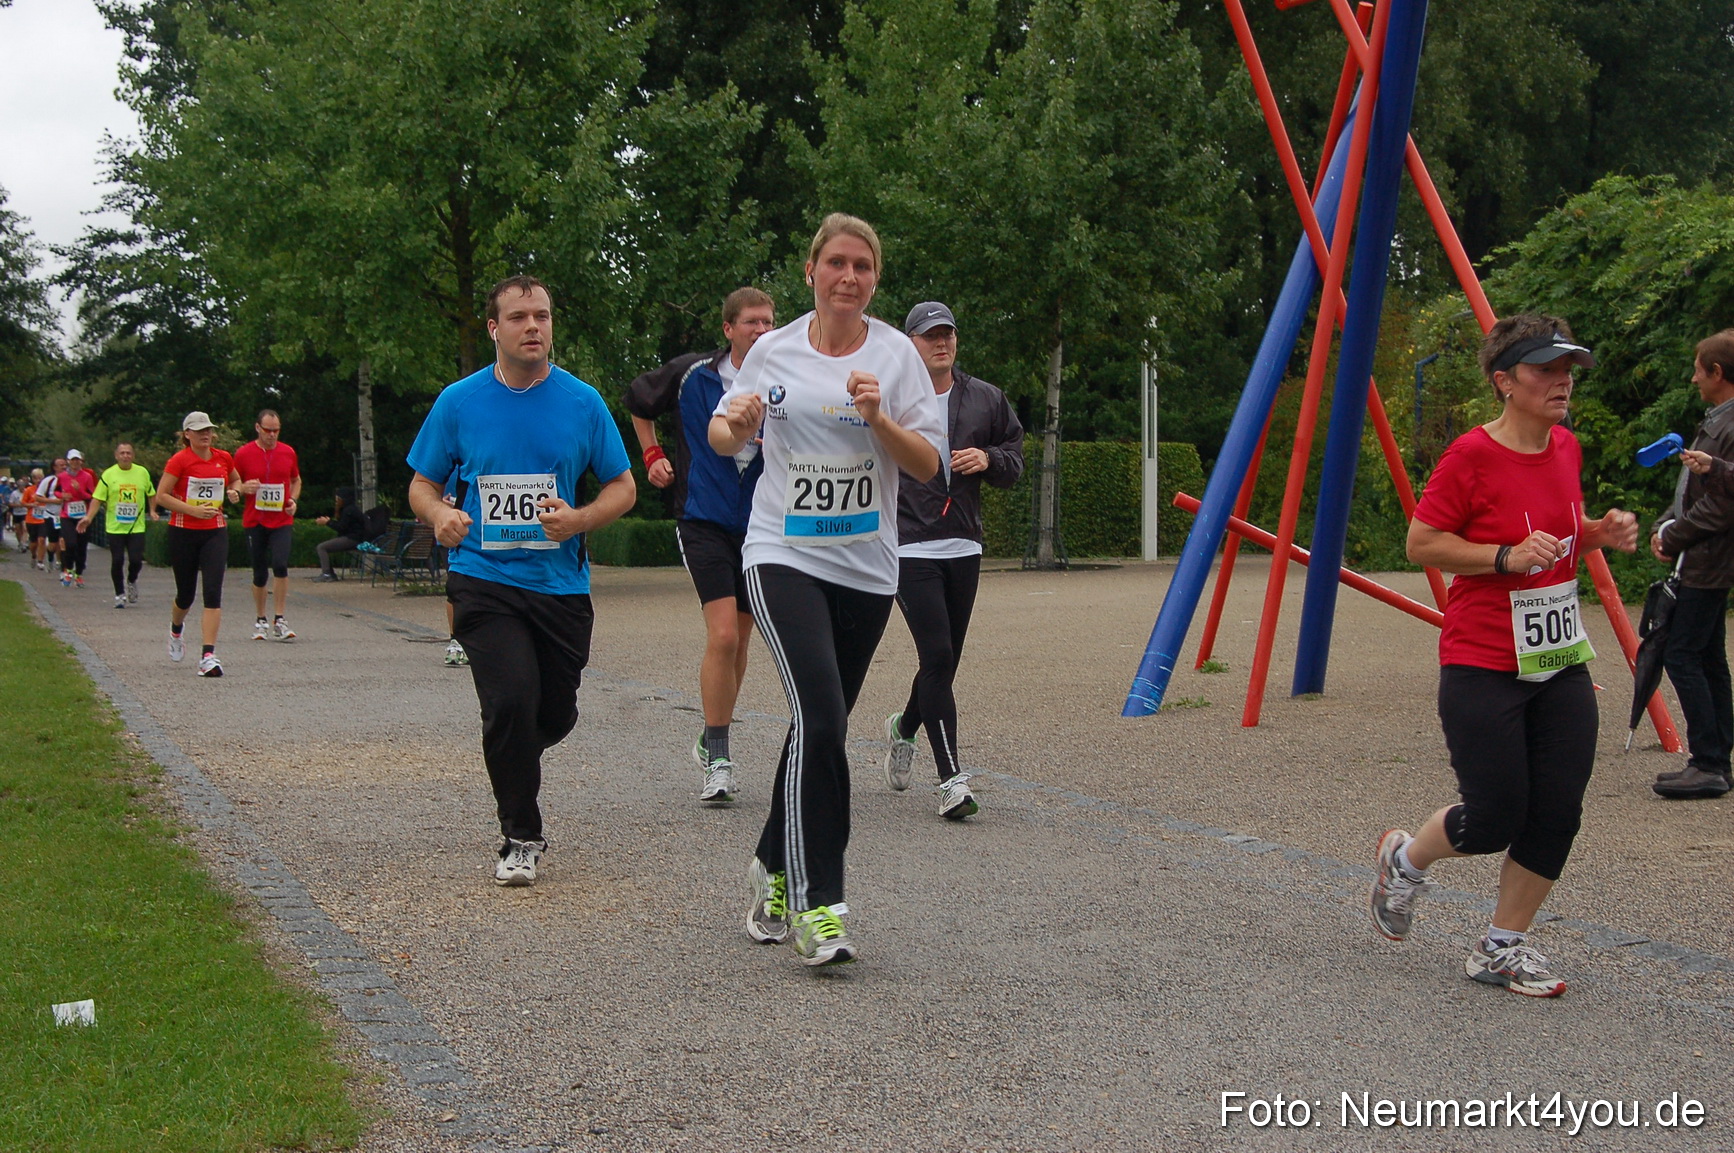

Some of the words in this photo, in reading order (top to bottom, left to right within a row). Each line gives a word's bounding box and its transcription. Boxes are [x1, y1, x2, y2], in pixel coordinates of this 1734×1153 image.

[788, 463, 818, 473] PARTL
[198, 486, 213, 498] 25
[261, 490, 280, 501] 313
[793, 476, 873, 511] 2970
[117, 507, 137, 516] 2027
[815, 520, 852, 534] Silvia
[500, 528, 538, 539] Marcus
[1513, 598, 1547, 609] PARTL
[1524, 603, 1577, 647] 5067
[1538, 649, 1580, 669] Gabriele
